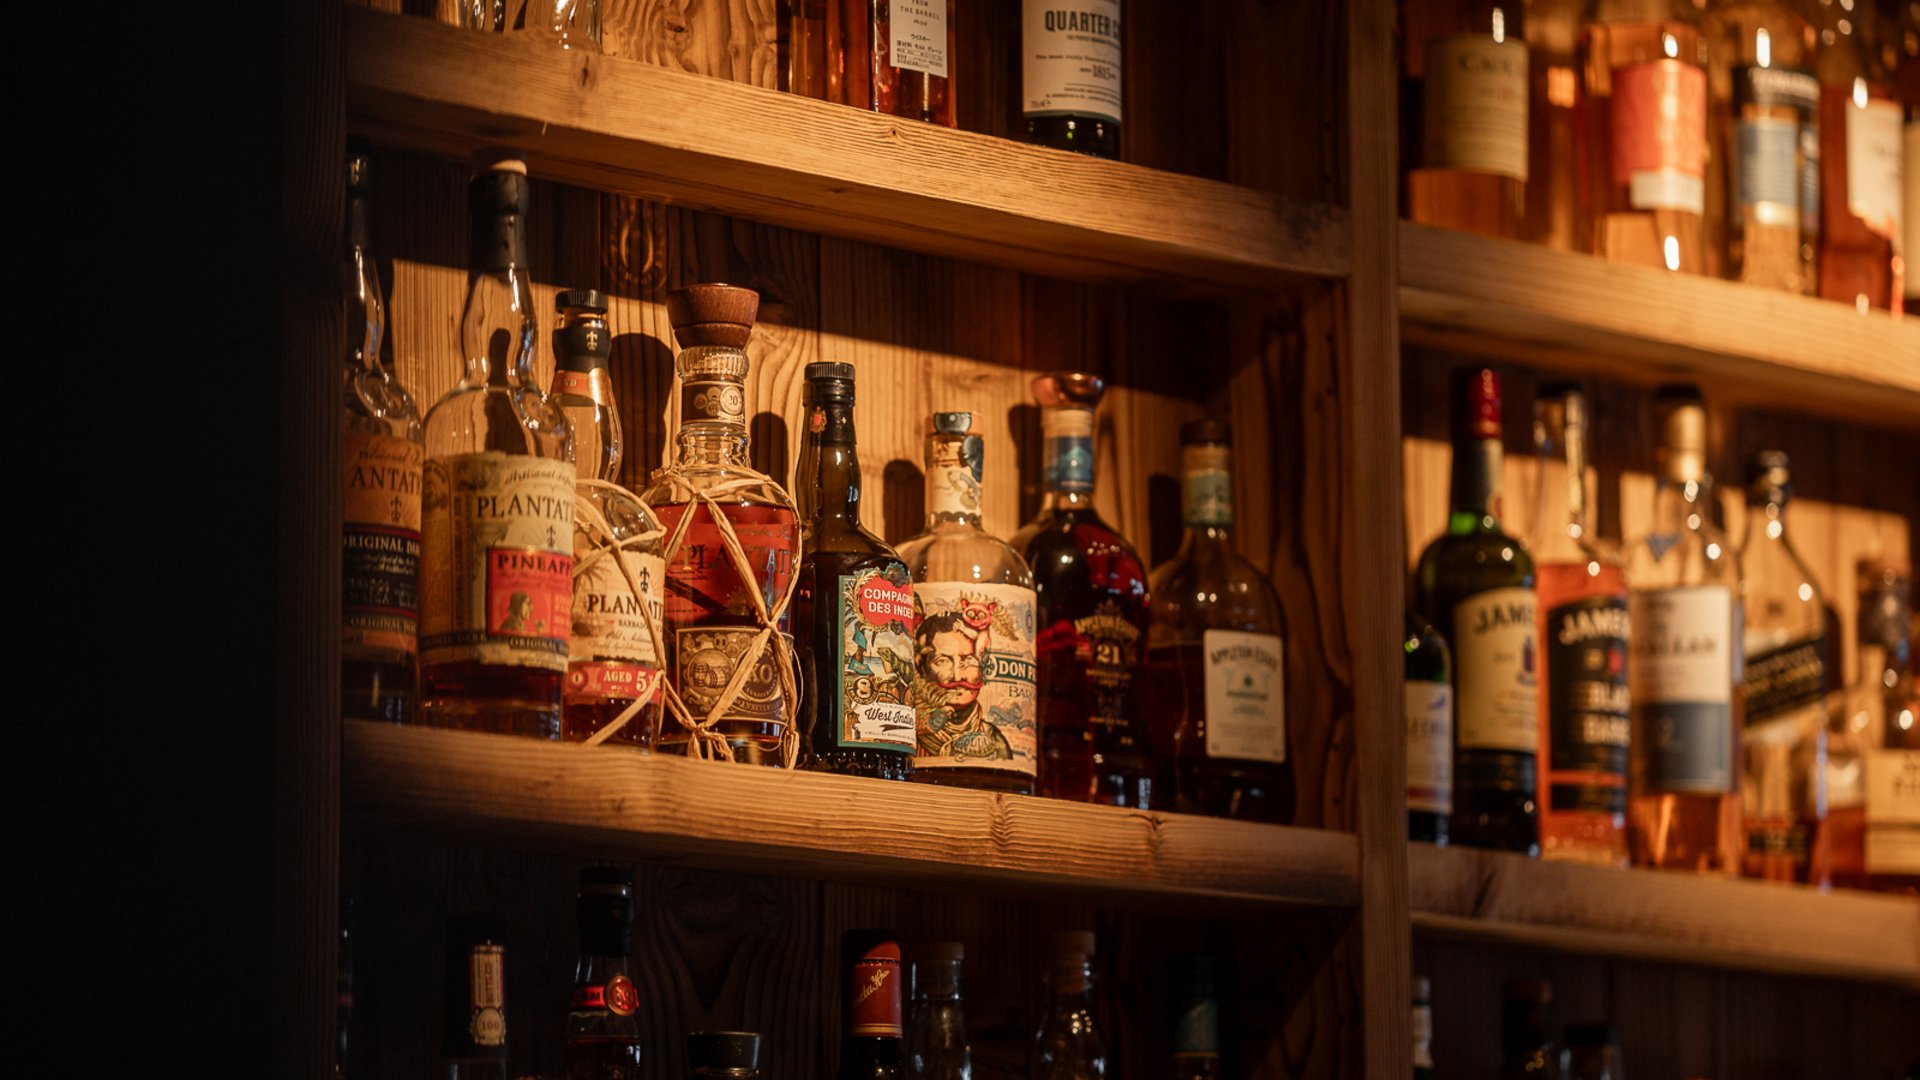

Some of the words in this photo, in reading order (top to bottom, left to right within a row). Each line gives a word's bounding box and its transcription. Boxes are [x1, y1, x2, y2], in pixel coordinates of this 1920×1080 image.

[1045, 10, 1111, 37] QUARTER
[868, 601, 891, 615] DES
[1096, 643, 1119, 665] 21
[998, 659, 1026, 678] DON
[603, 670, 632, 683] AGED
[635, 670, 648, 693] 5
[856, 678, 872, 699] 8
[864, 706, 893, 723] West
